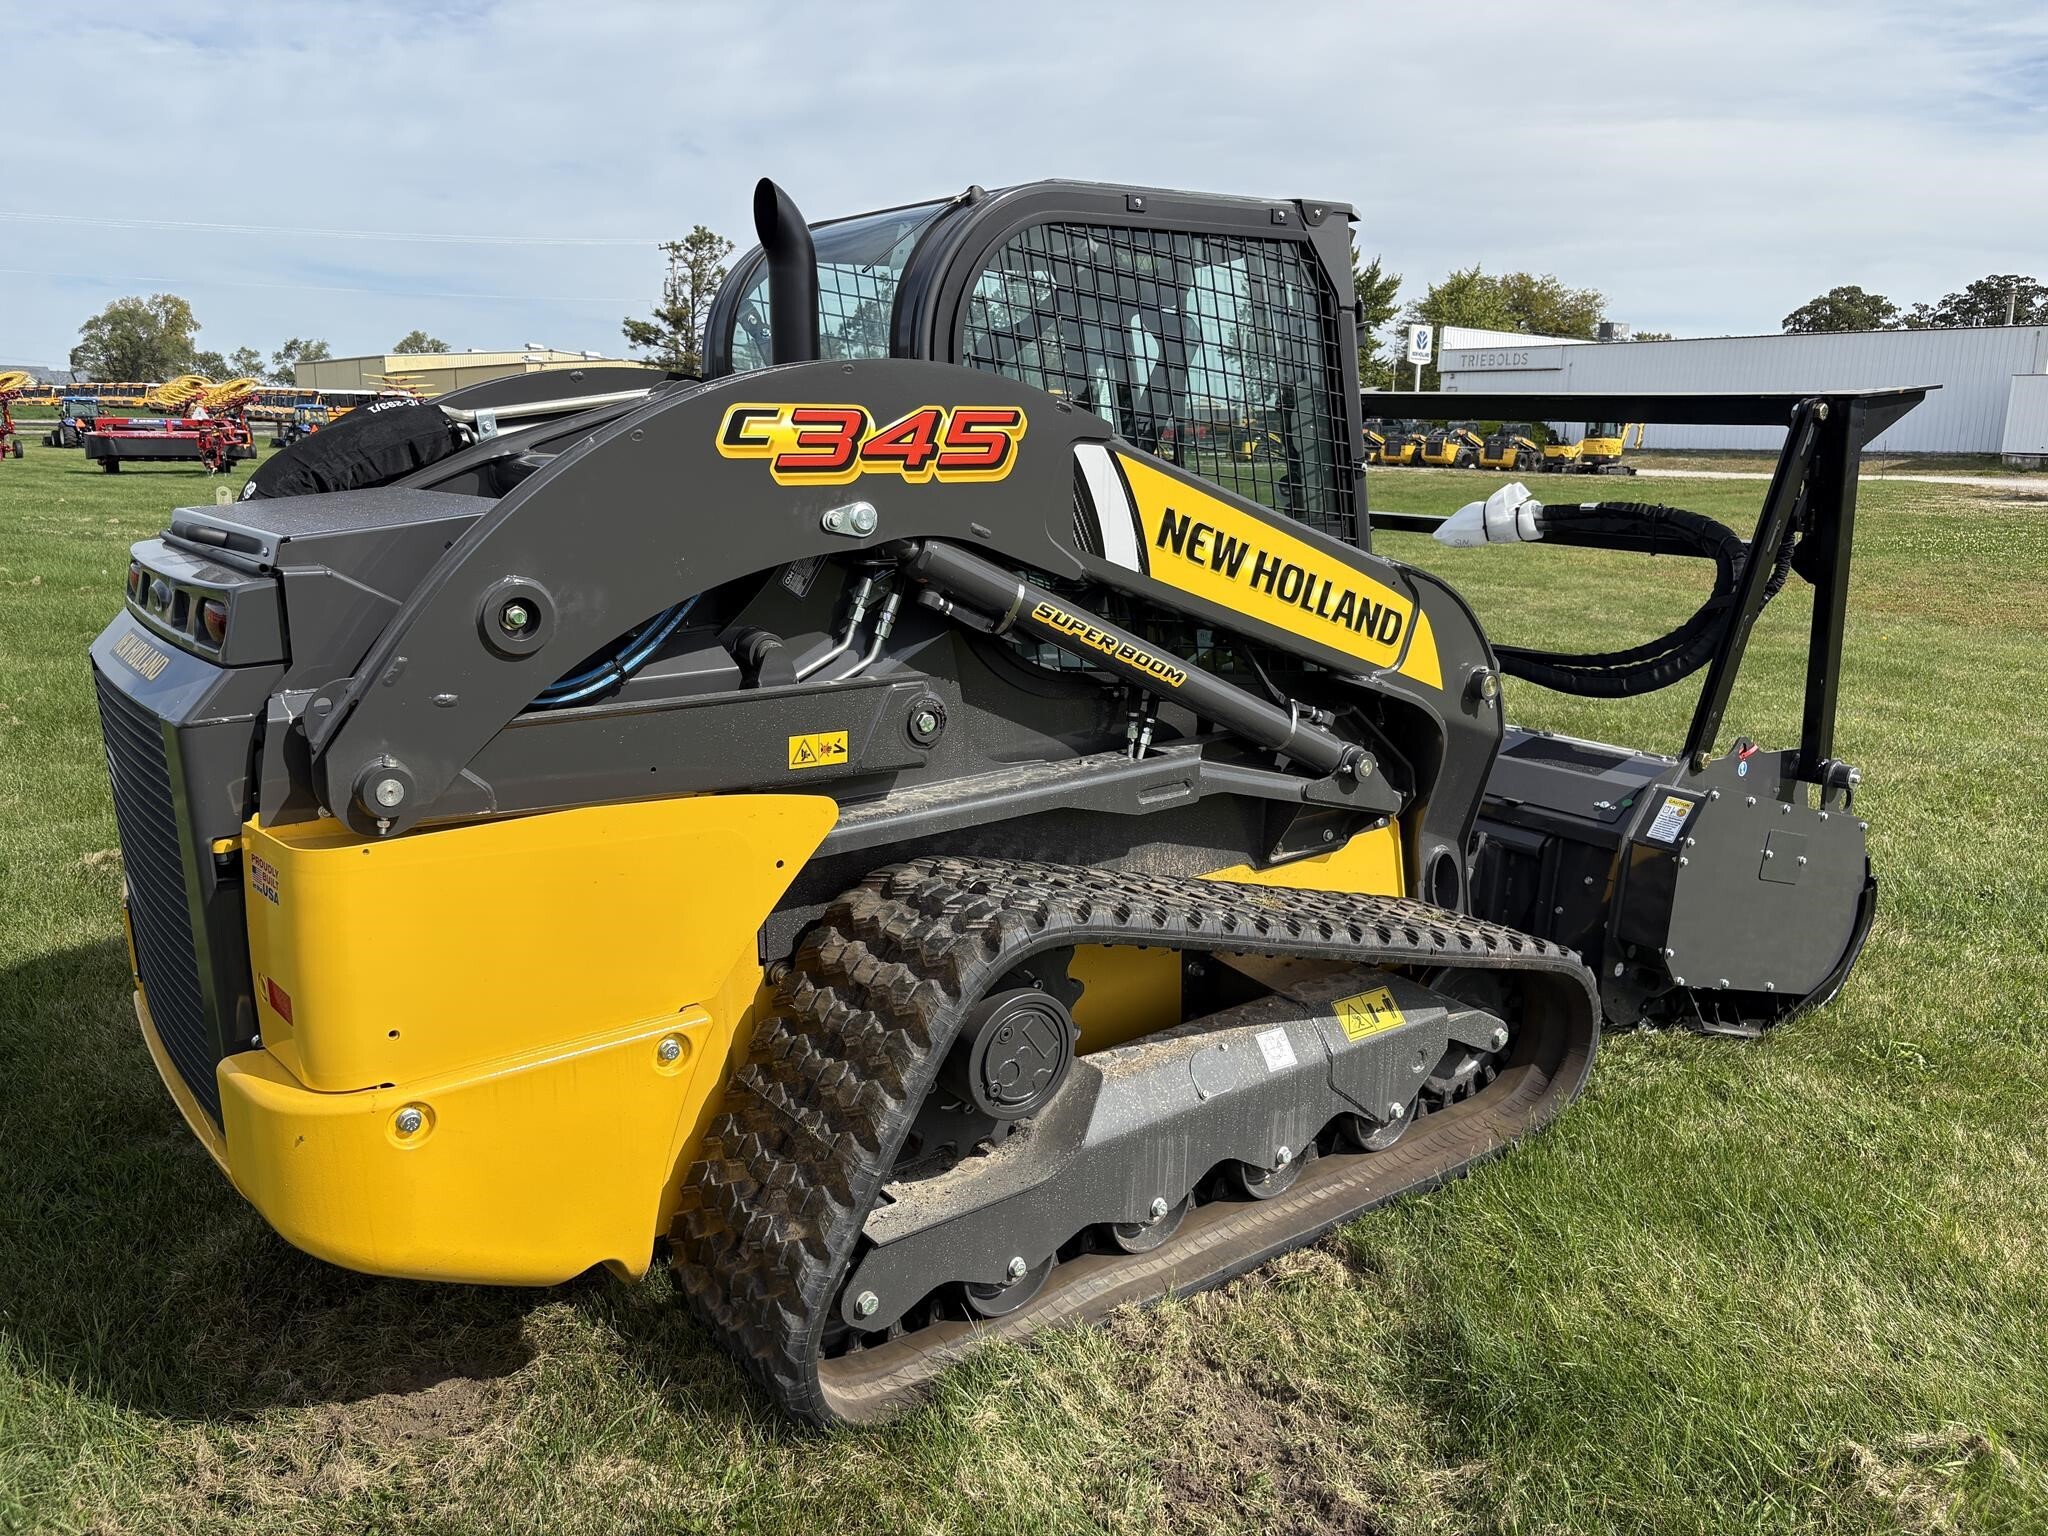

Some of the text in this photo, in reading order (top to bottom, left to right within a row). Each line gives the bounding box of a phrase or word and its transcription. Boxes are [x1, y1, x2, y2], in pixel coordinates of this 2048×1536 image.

[1461, 352, 1528, 367] TRIEBOLDS
[1155, 507, 1403, 647] NEW HOLLAND
[1033, 602, 1186, 685] SUPER BOOM
[123, 639, 170, 681] HOLLAND
[251, 853, 279, 879] PROUDLY
[262, 871, 279, 891] BUILT
[262, 882, 280, 907] USA
